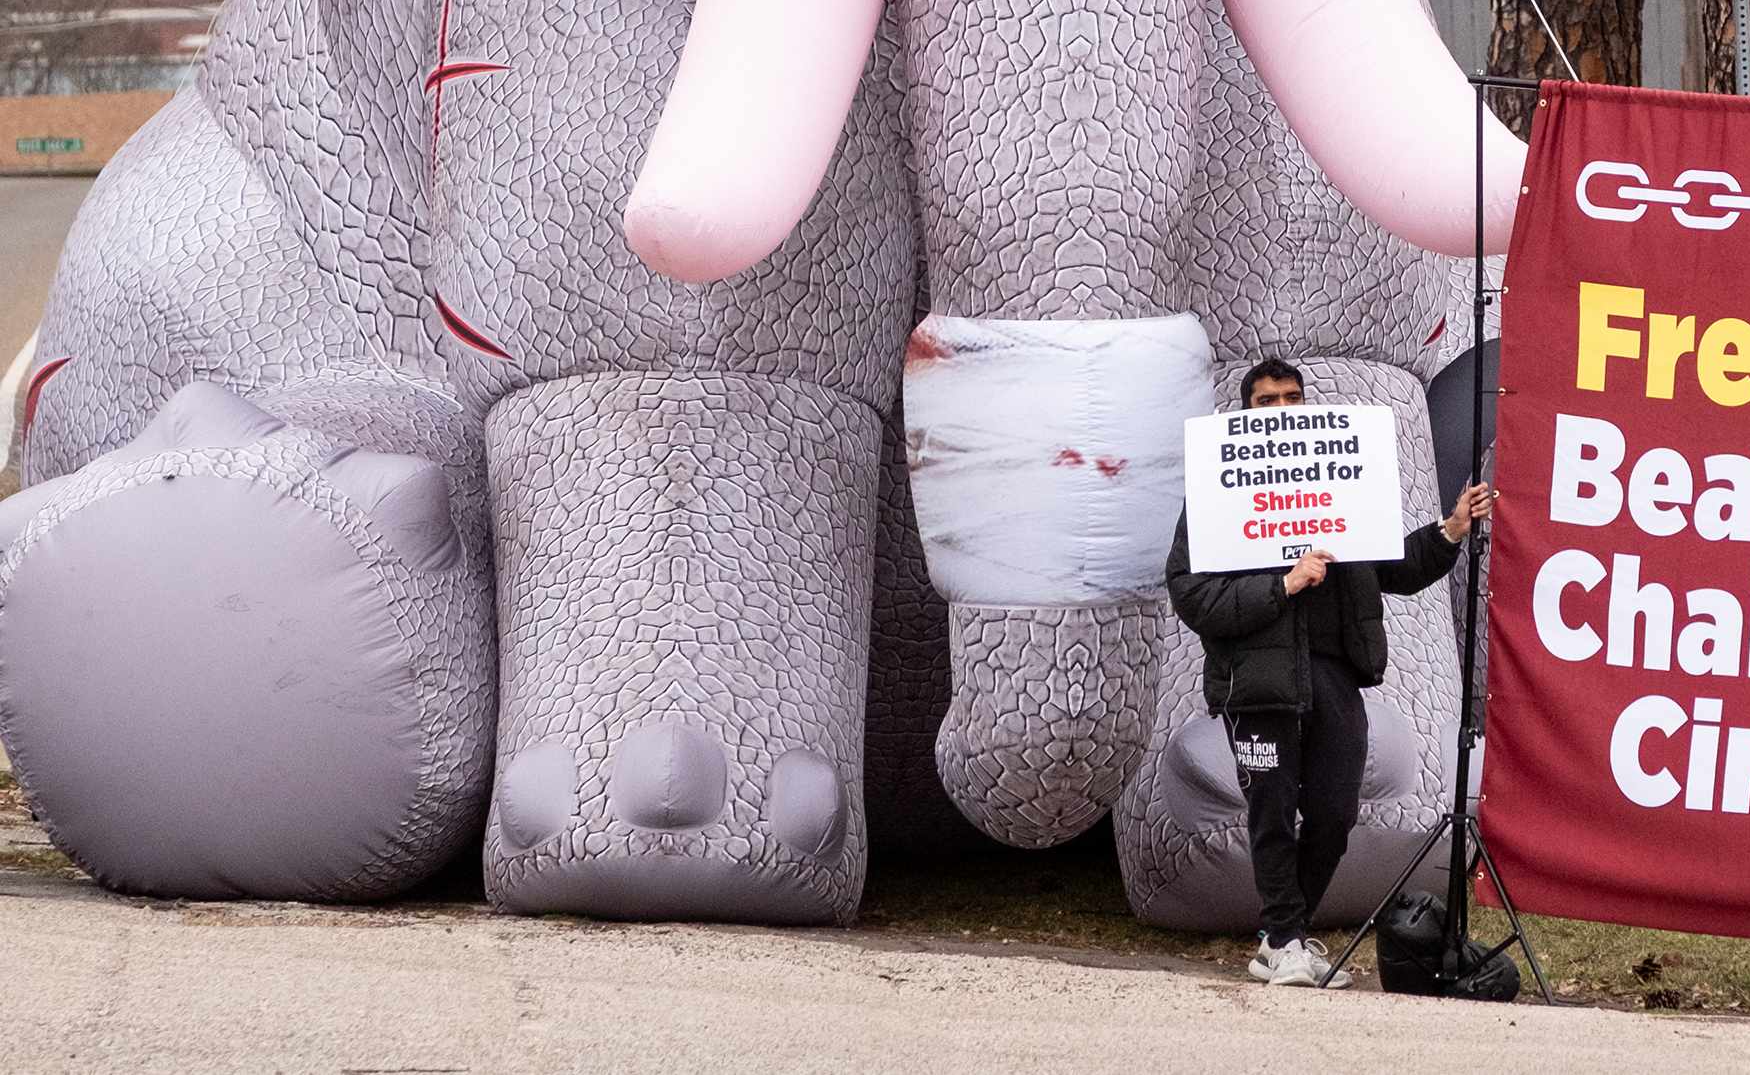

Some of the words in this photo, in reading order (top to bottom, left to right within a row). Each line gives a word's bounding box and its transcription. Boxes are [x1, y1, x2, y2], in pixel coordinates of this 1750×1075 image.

[1228, 411, 1350, 436] Elephants
[1221, 439, 1307, 462] Beaten
[1313, 435, 1359, 456] and
[1220, 462, 1321, 488] Chained
[1327, 462, 1363, 481] for
[1253, 490, 1333, 512] Shrine
[1243, 518, 1347, 540] Circuses
[1236, 741, 1252, 754] THE
[1253, 742, 1276, 755] IRON
[1237, 753, 1279, 768] PARADISE
